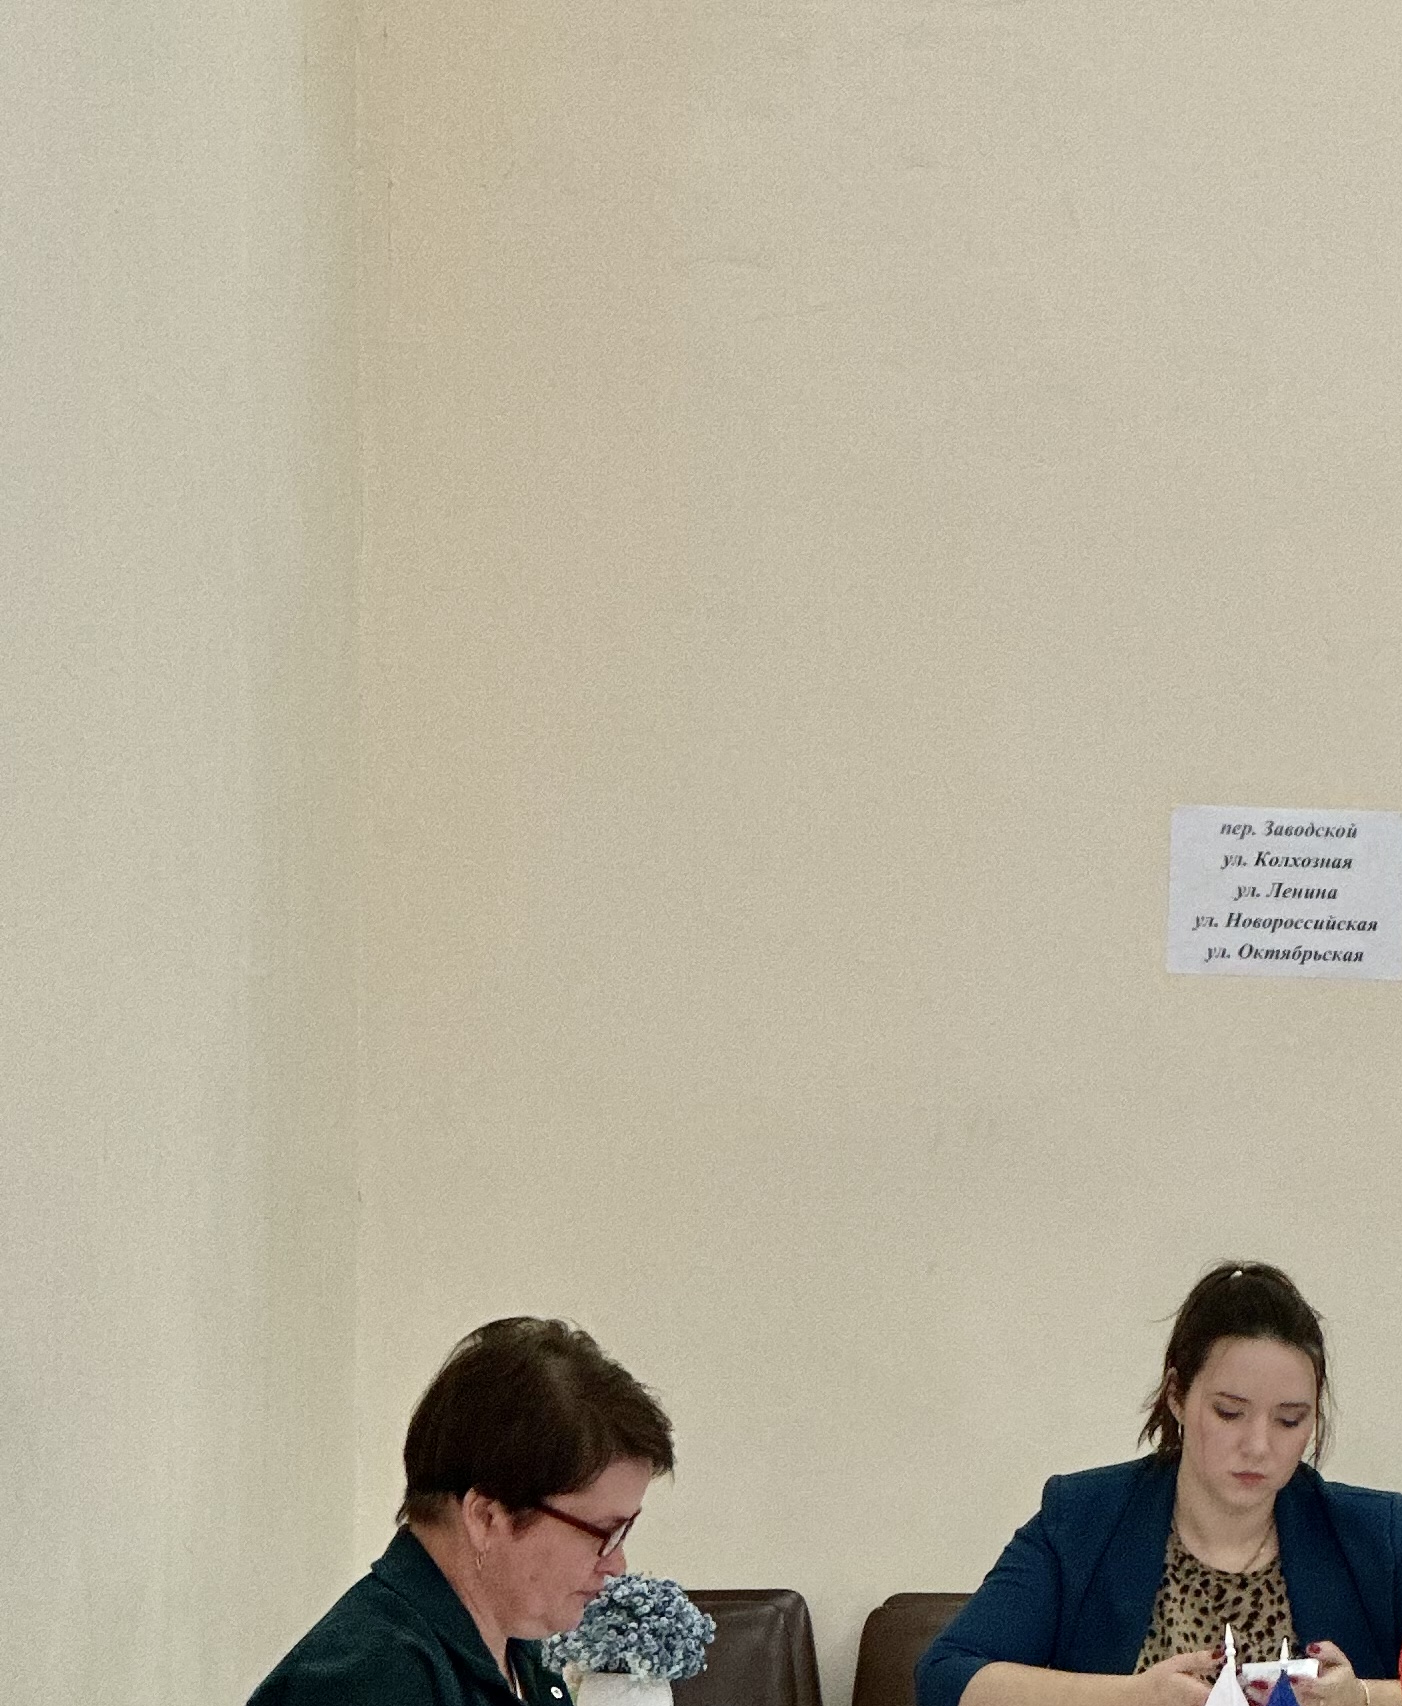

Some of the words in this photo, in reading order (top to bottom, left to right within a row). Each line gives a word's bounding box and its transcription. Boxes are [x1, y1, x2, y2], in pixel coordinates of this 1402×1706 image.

[1220, 823, 1257, 839] пер.
[1264, 820, 1358, 839] Заводской
[1221, 853, 1248, 870] ул.
[1254, 851, 1353, 869] Колхозная
[1234, 885, 1261, 901] ул.
[1266, 882, 1338, 900] Ленина
[1192, 915, 1218, 930] ул.
[1225, 913, 1378, 932] Новороссийская
[1205, 946, 1231, 962] ул.
[1237, 943, 1364, 964] Октябрьская
